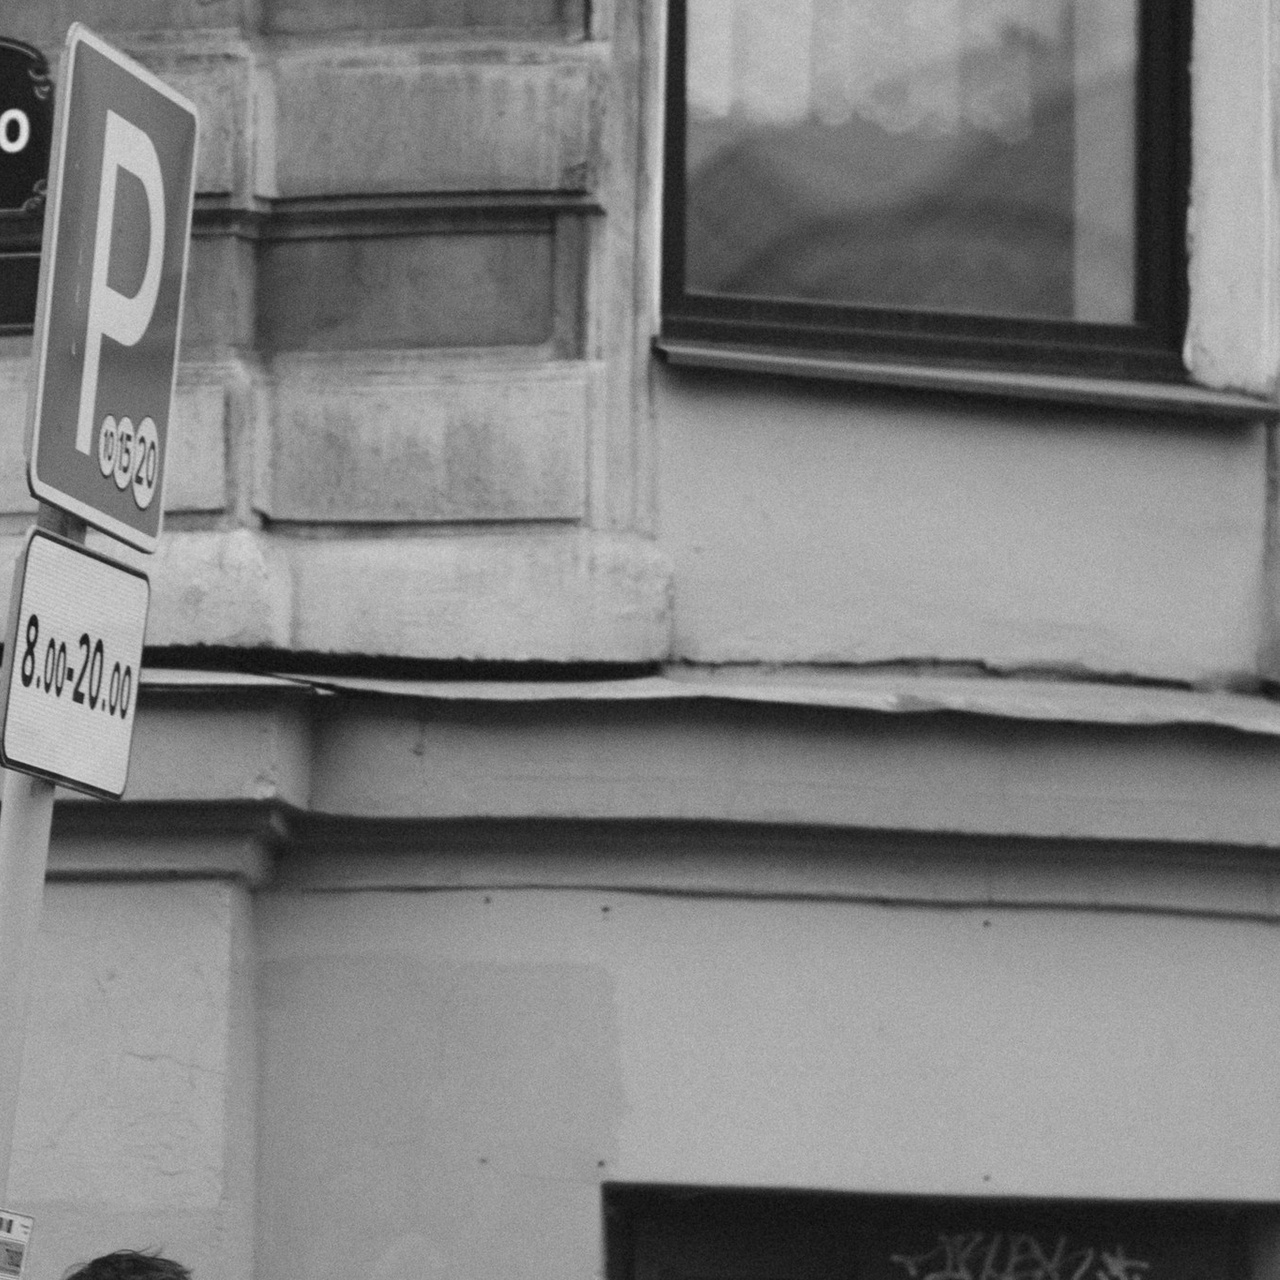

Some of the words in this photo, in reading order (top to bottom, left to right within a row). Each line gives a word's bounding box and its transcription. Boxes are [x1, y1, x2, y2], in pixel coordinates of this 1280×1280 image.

[75, 109, 166, 456] P
[103, 428, 115, 462] 10
[117, 429, 133, 474] 15
[135, 434, 157, 490] 20
[20, 613, 132, 720] 8.00-20.00
